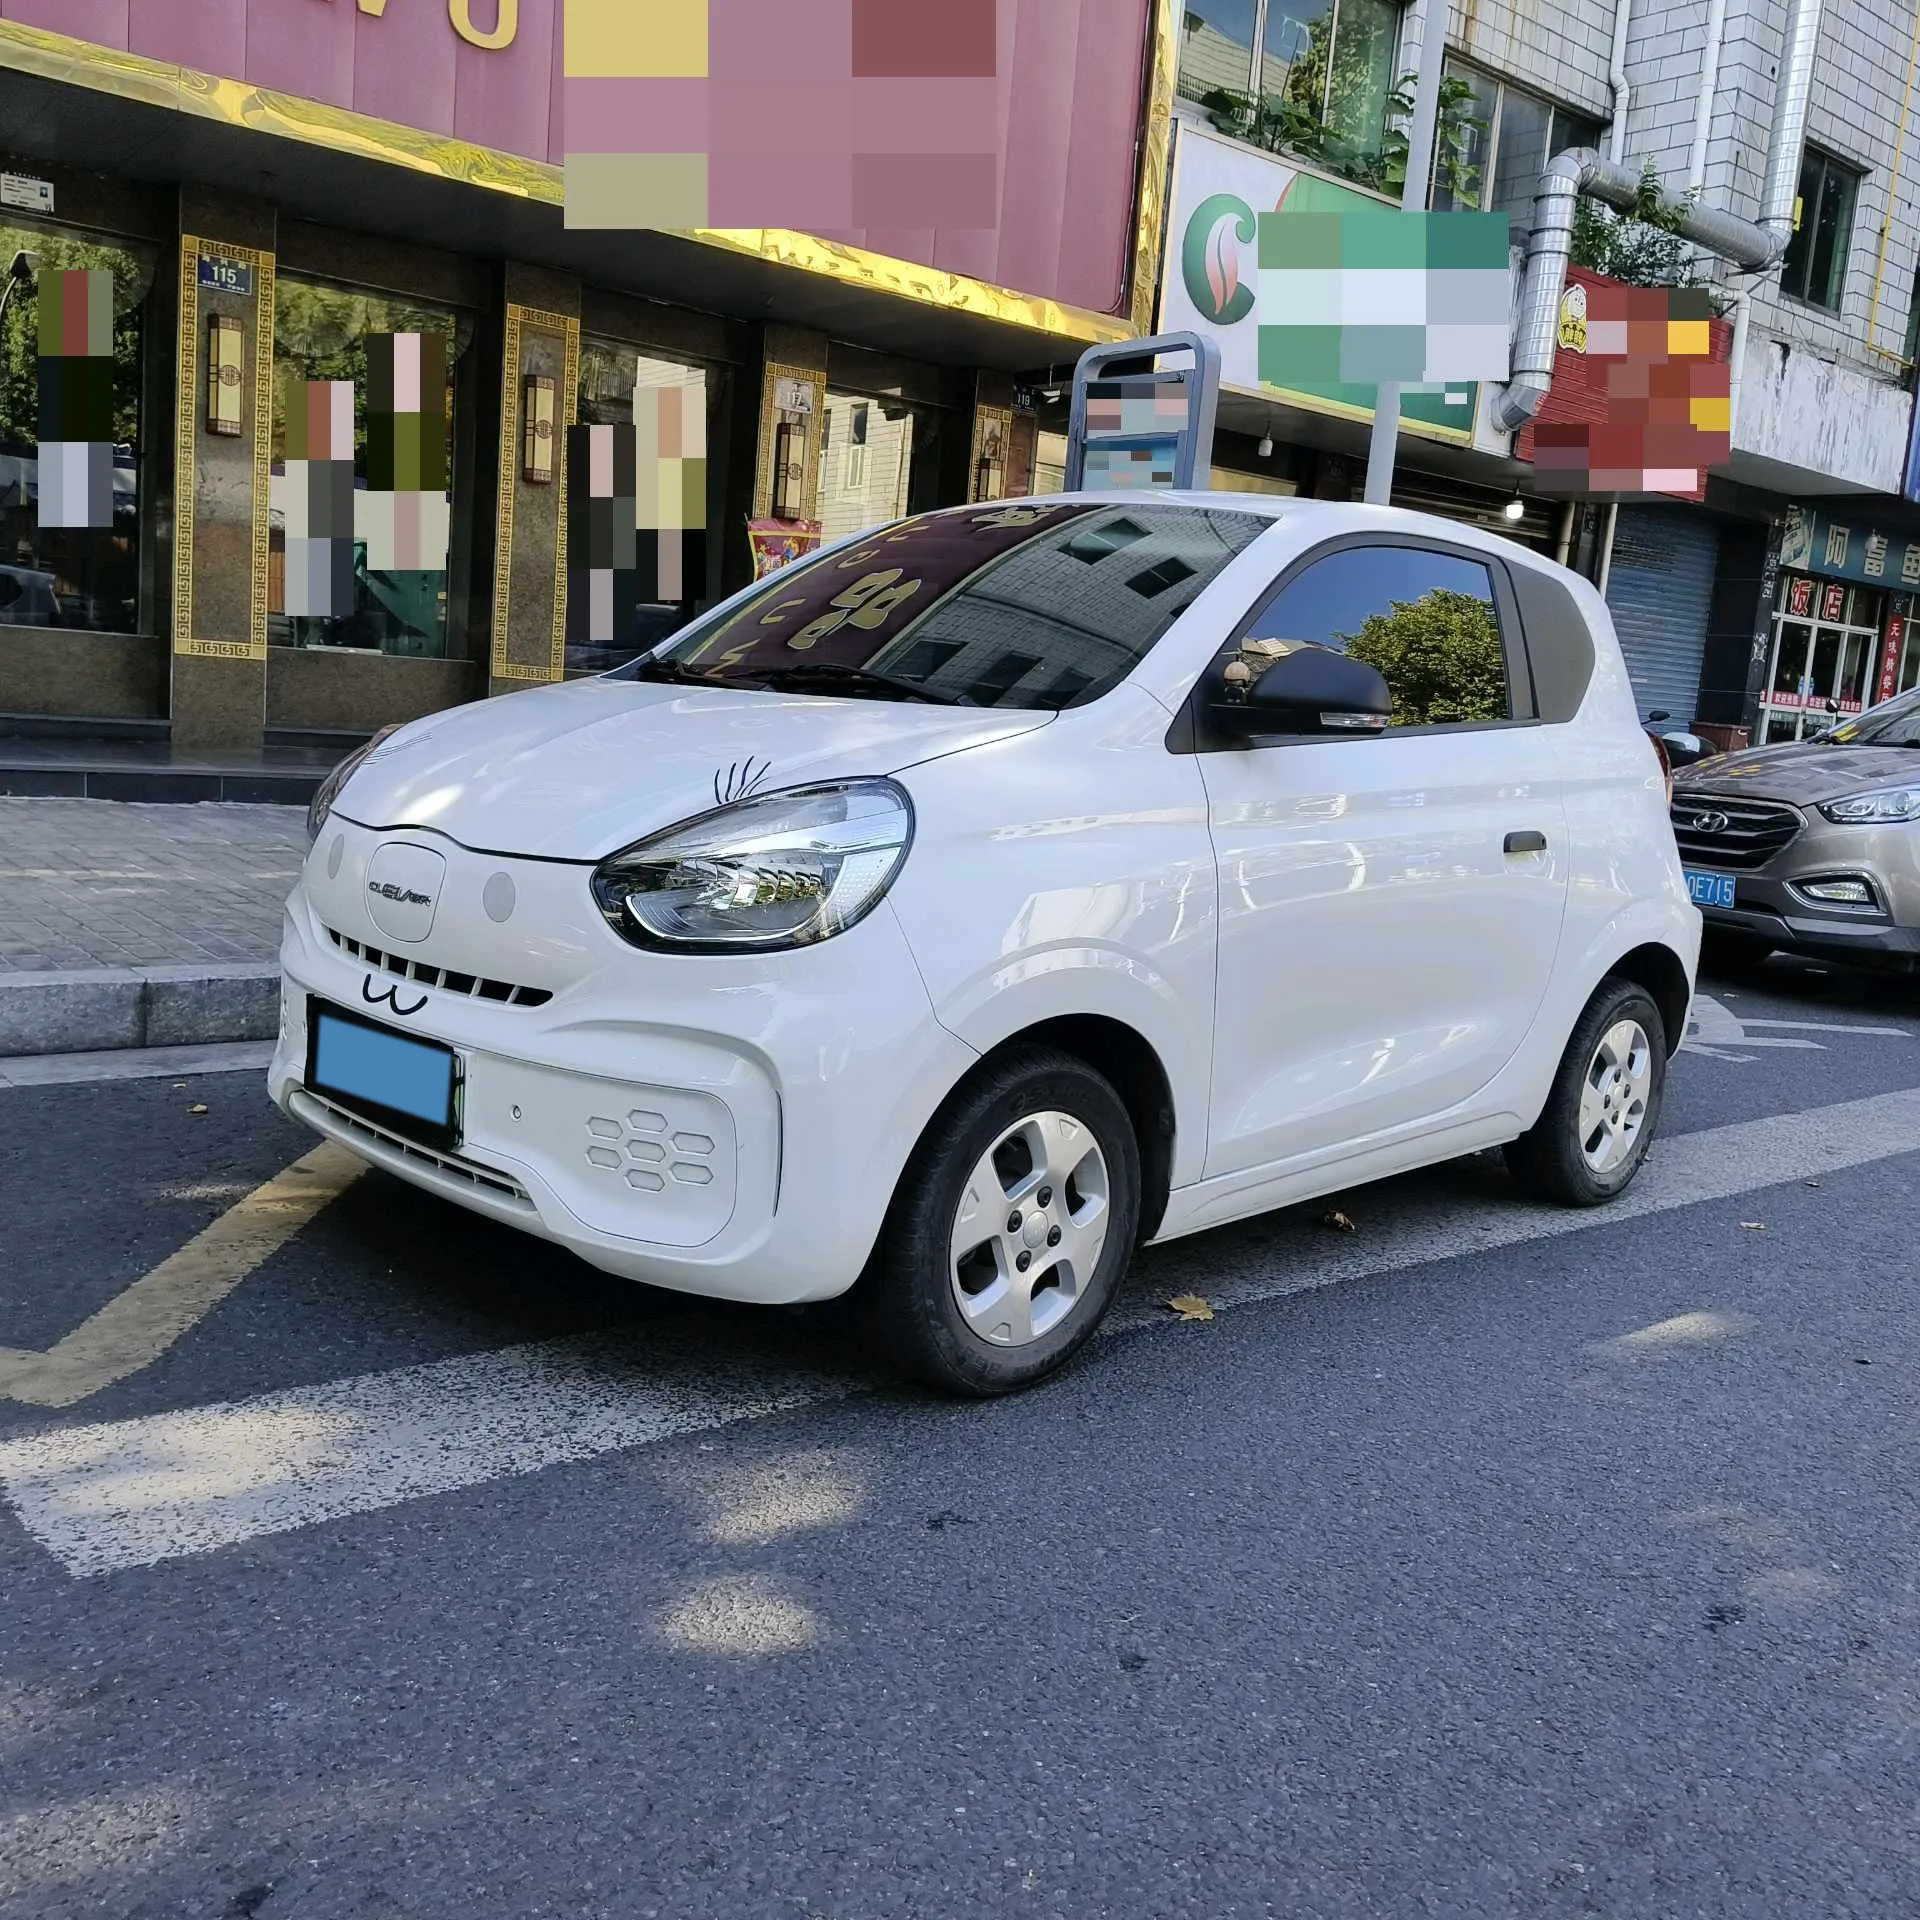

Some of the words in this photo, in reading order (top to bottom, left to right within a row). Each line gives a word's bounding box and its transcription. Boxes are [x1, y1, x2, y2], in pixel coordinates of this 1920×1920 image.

[212, 266, 237, 284] 115
[1790, 577, 1844, 621] 饭店
[368, 881, 431, 907] CLEVER
